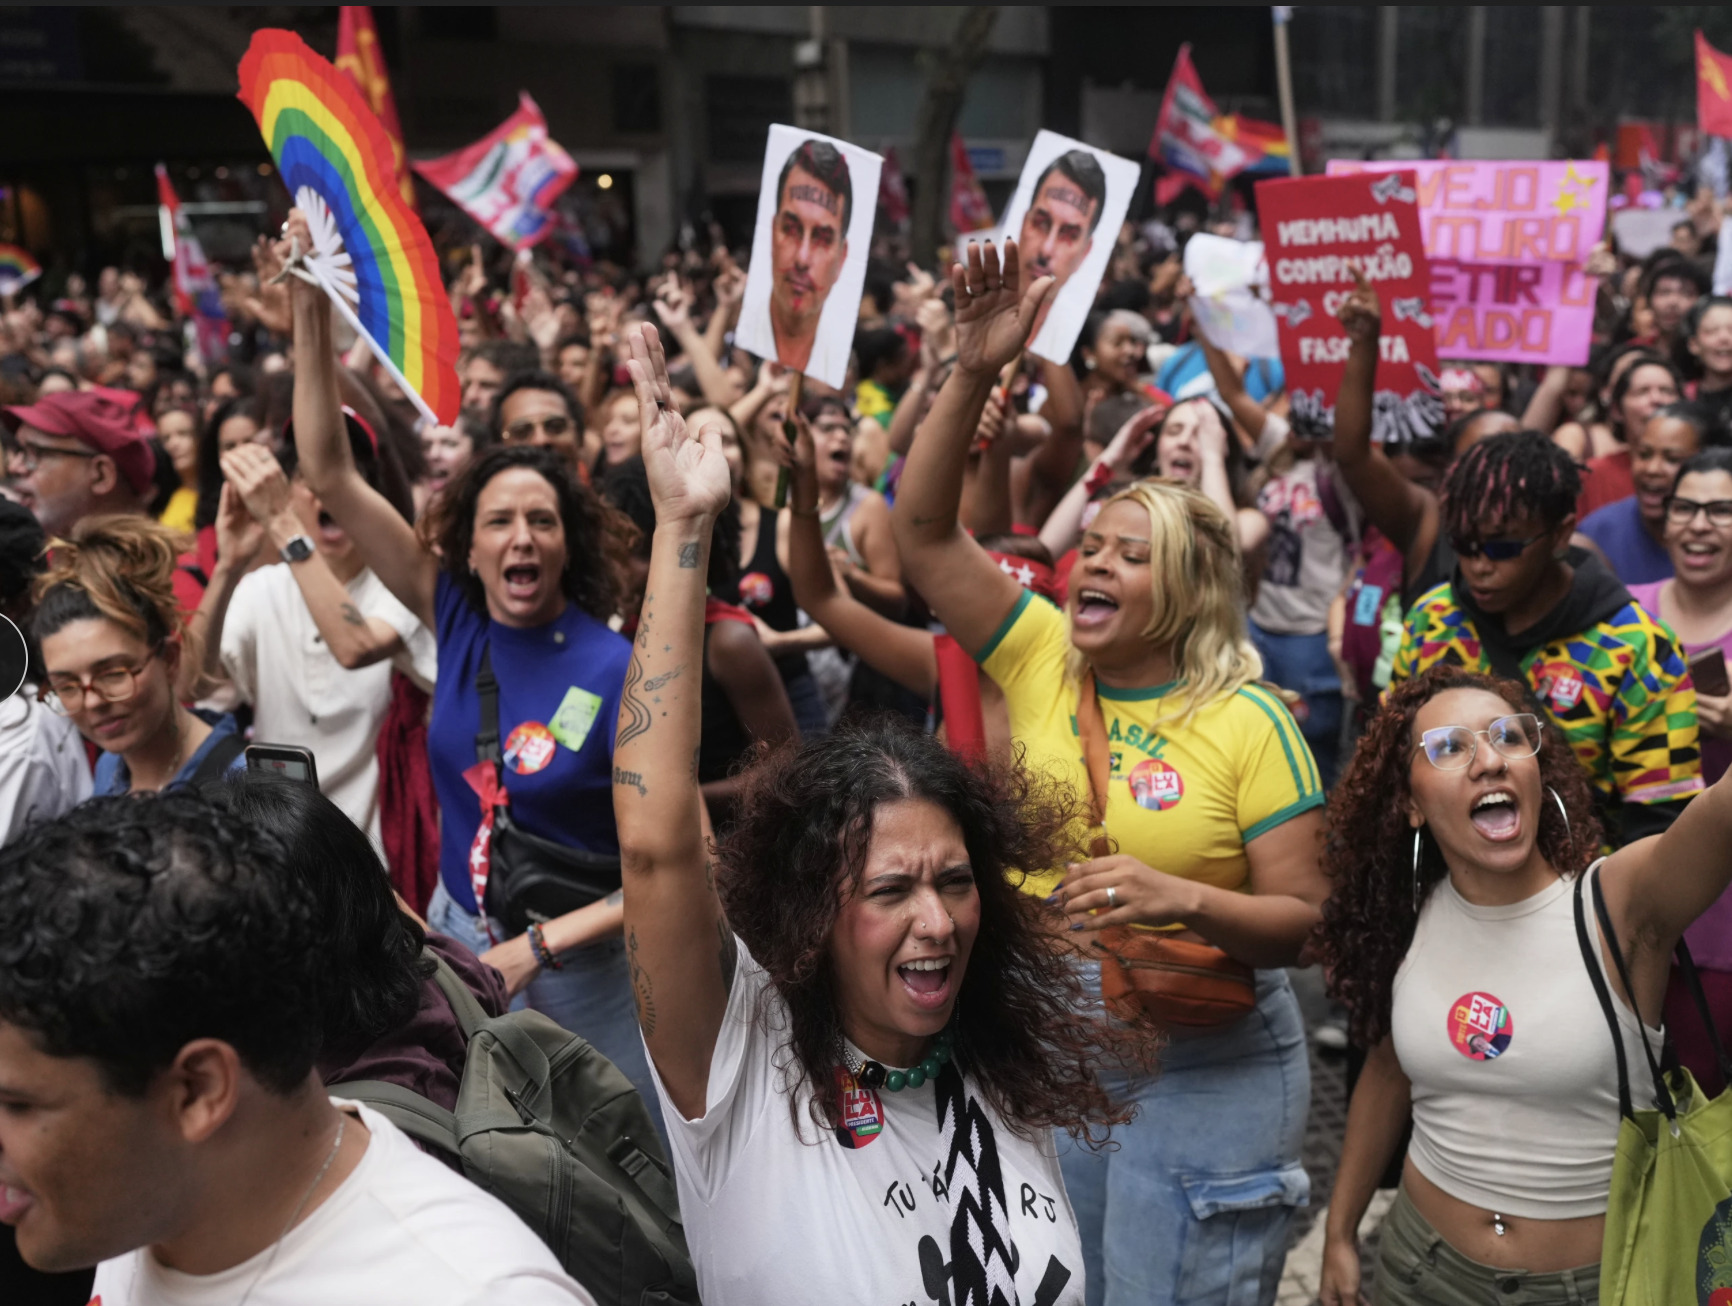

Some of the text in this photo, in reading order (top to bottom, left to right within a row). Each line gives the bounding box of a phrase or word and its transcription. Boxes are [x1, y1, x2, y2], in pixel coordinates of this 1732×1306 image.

[1415, 166, 1539, 212] VEJO
[1424, 216, 1581, 261] TURO
[1299, 335, 1410, 365] FASCTA
[1070, 714, 1168, 760] ASIL
[884, 1180, 916, 1218] TU
